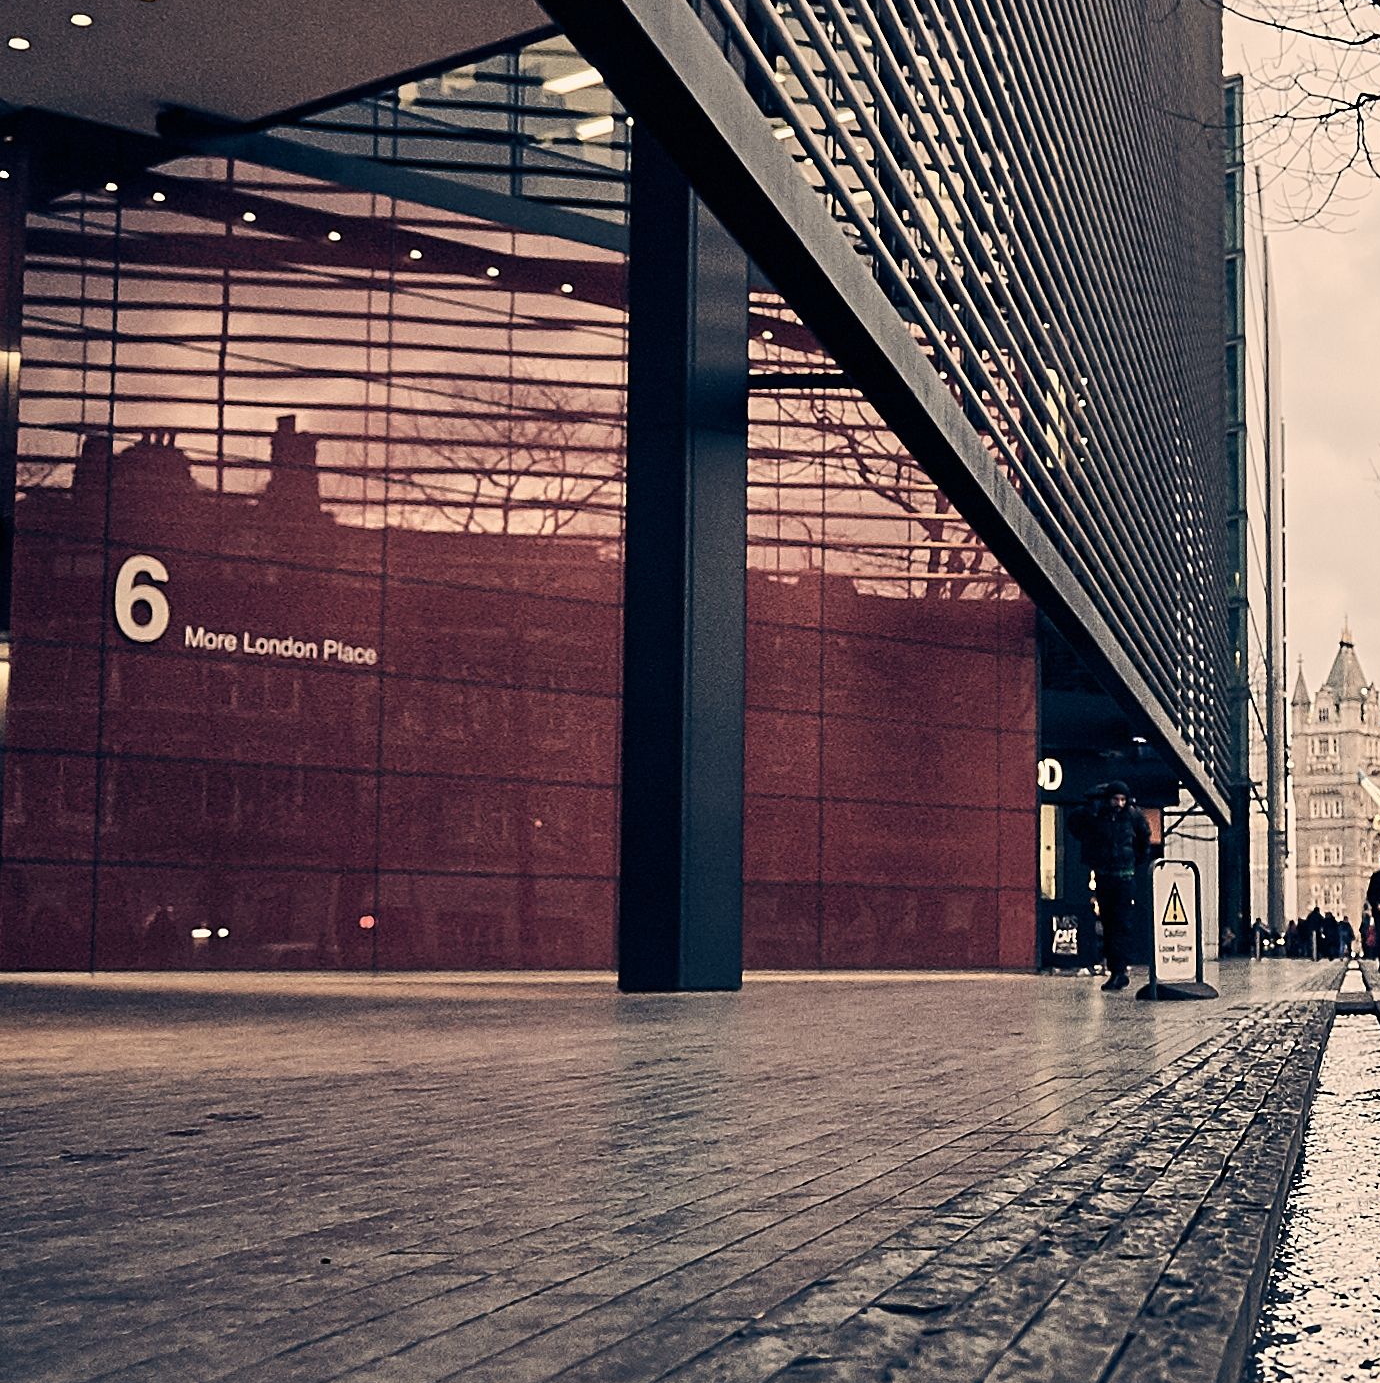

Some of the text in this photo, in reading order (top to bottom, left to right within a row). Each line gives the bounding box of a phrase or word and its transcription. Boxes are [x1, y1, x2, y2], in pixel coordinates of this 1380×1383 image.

[115, 554, 170, 643] 6
[184, 625, 378, 666] More London Place
[1163, 928, 1187, 938] Caution
